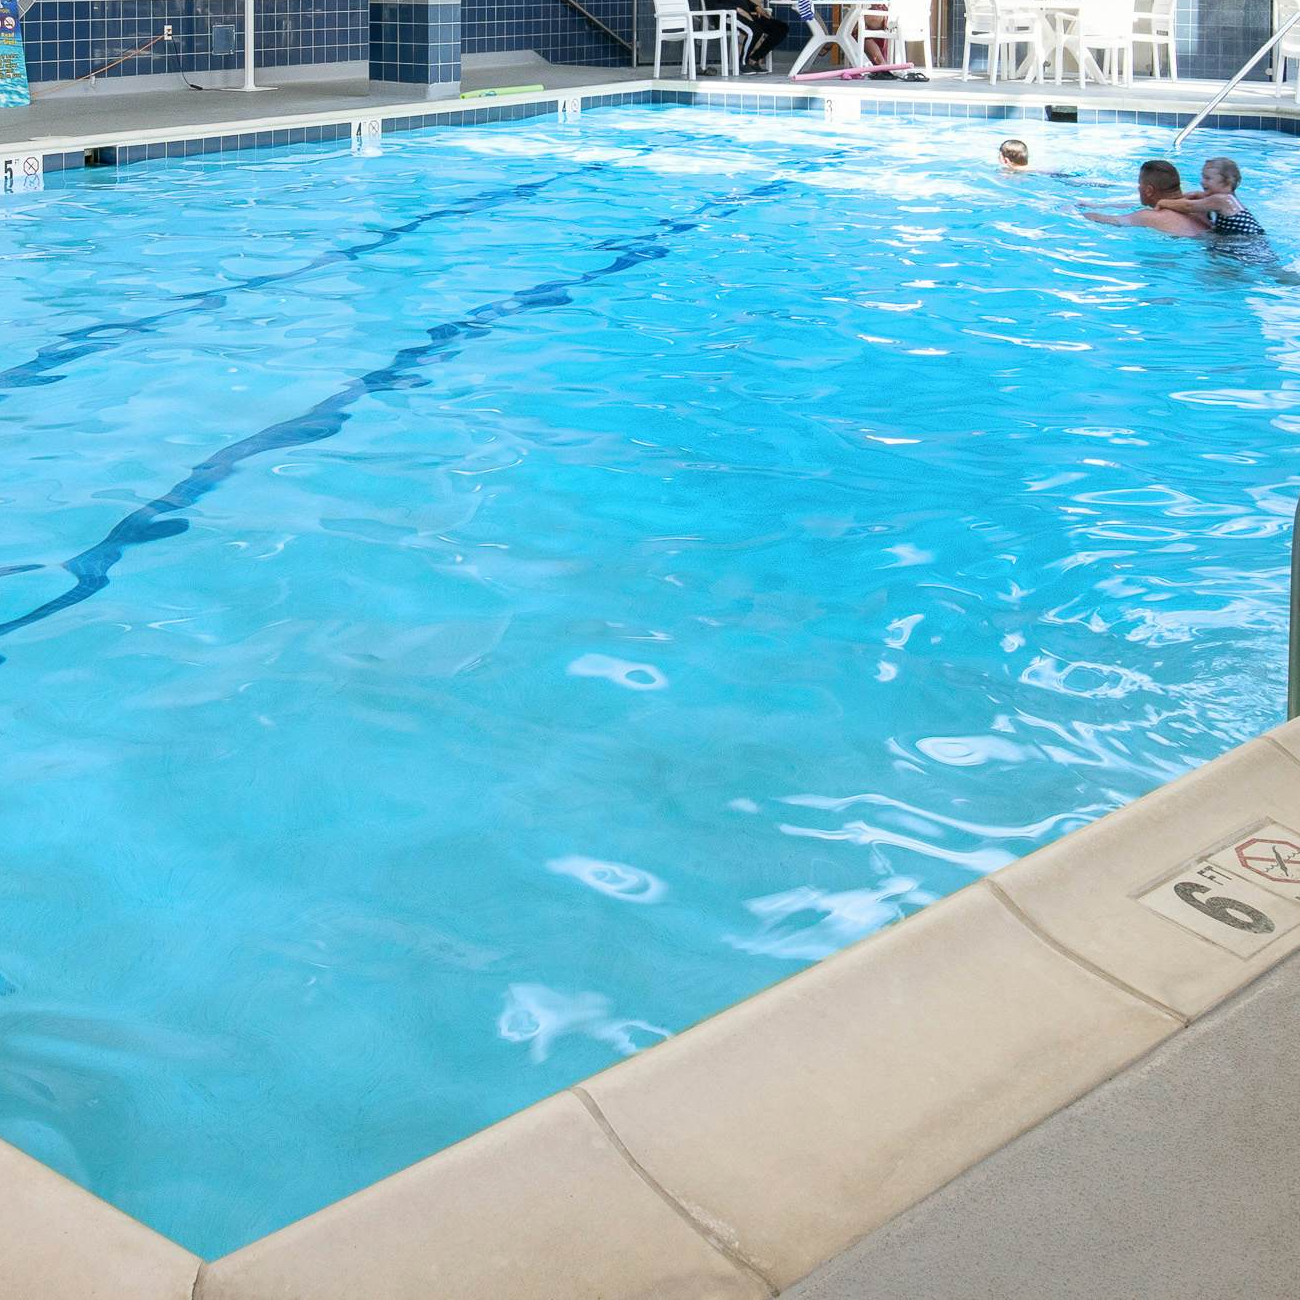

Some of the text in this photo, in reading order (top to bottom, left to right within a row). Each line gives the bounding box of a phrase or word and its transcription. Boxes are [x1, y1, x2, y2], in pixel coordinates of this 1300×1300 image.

[356, 122, 361, 136] 4
[1173, 865, 1276, 934] 6 FT
